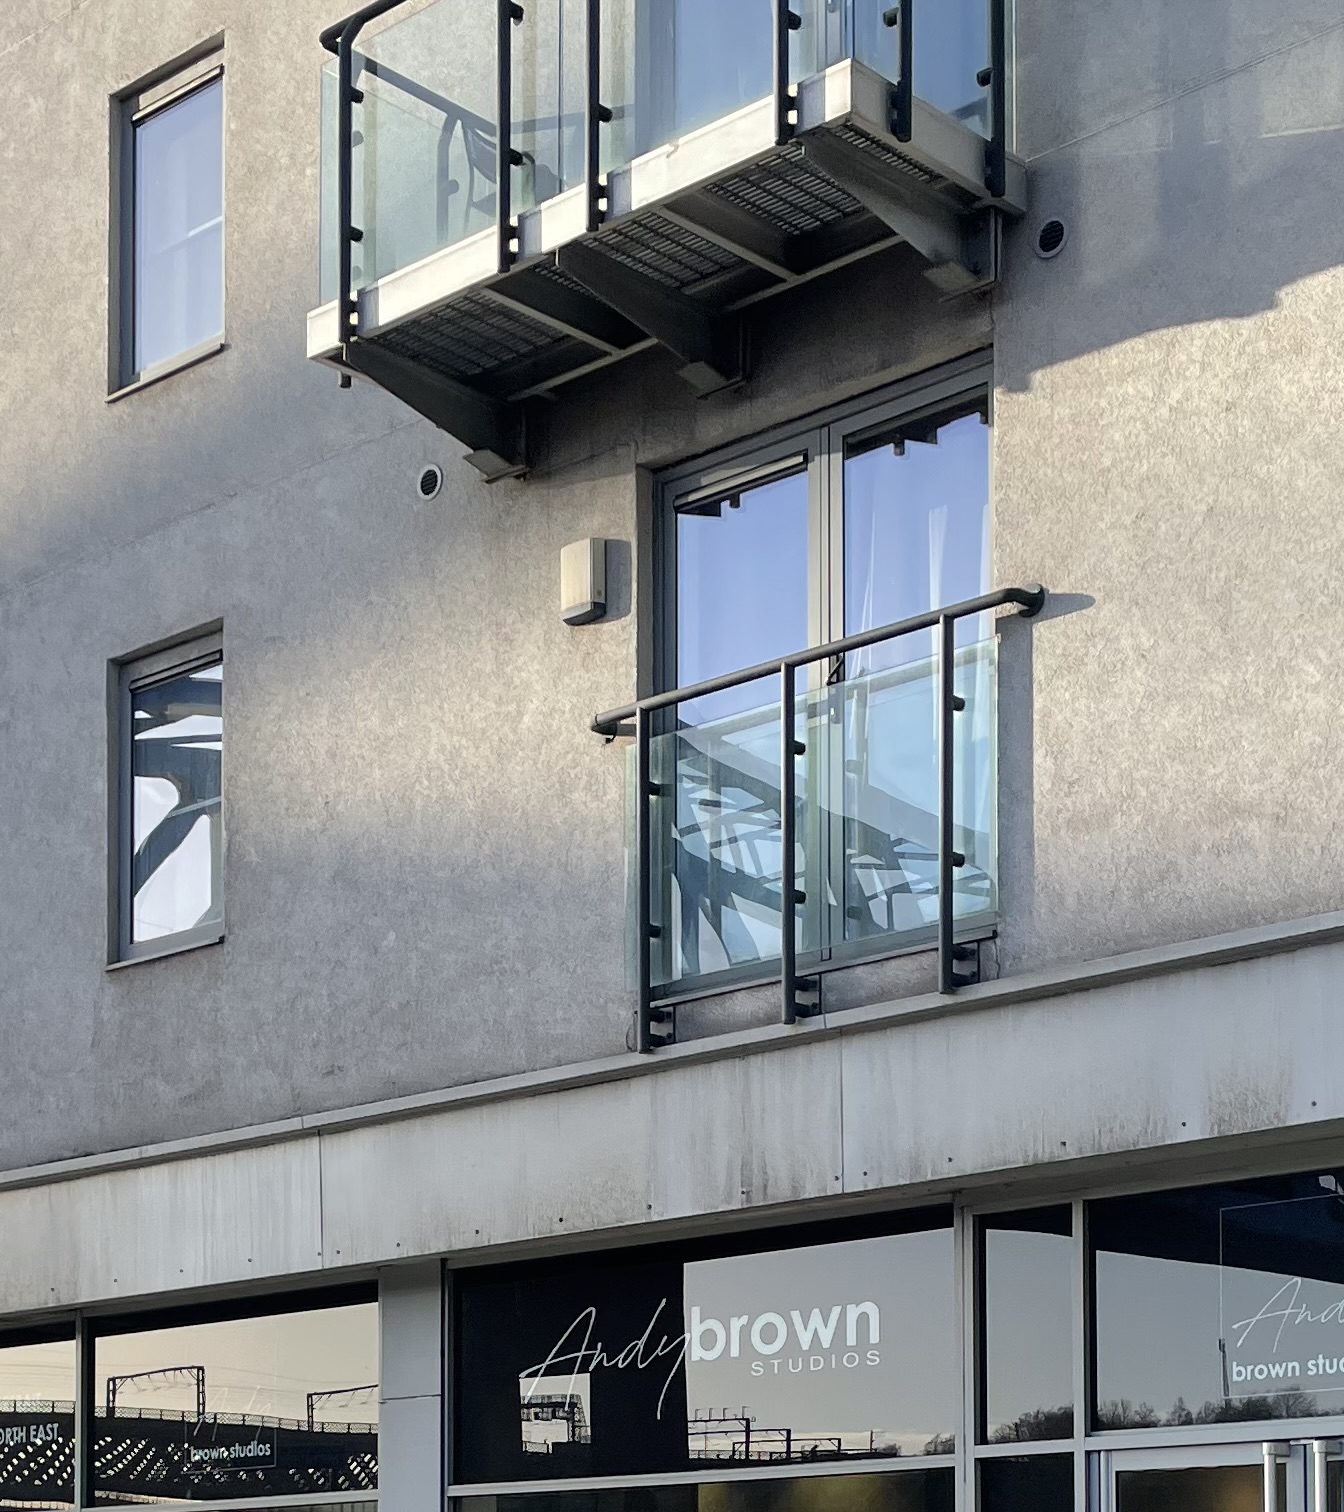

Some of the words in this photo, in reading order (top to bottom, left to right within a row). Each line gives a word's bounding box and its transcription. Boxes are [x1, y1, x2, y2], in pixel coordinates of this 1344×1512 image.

[519, 1298, 692, 1420] Andy
[690, 1301, 881, 1362] brown
[751, 1350, 882, 1376] STUDIOS
[1232, 1357, 1301, 1383] brown
[30, 1422, 59, 1443] EAST
[229, 1440, 271, 1459] studios
